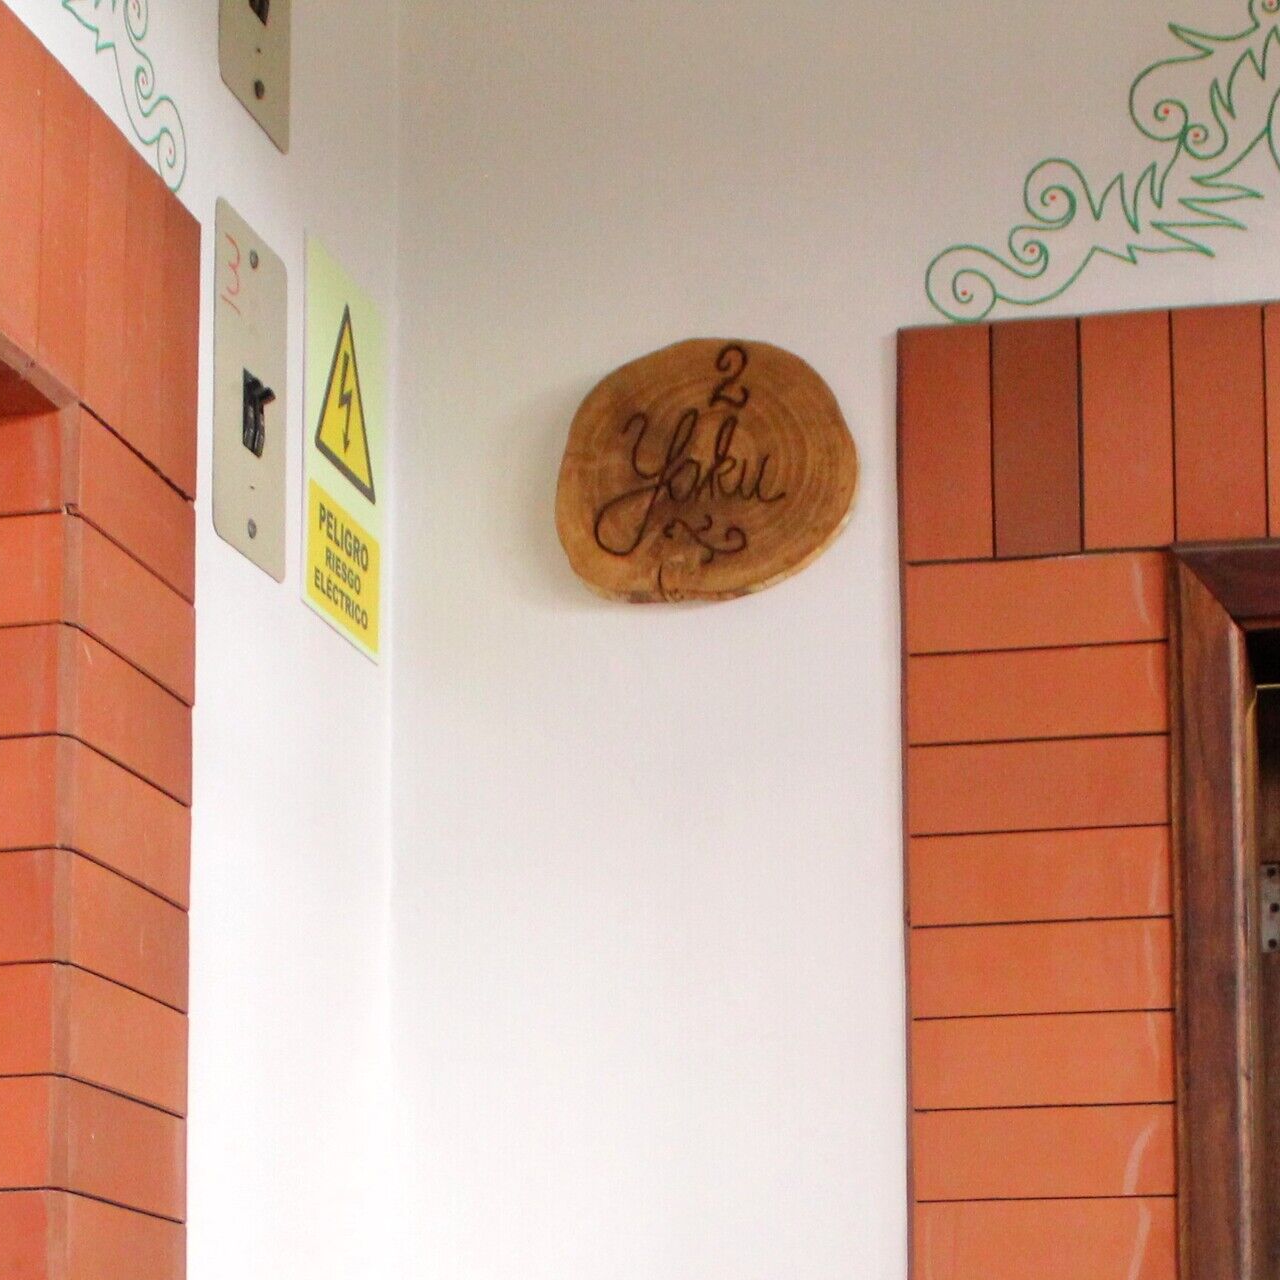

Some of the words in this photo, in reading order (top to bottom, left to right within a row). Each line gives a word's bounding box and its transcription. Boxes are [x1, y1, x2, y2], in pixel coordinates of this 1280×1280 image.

[708, 342, 751, 408] 2
[319, 502, 370, 573] PELIGRO
[325, 546, 362, 596] RIESGO
